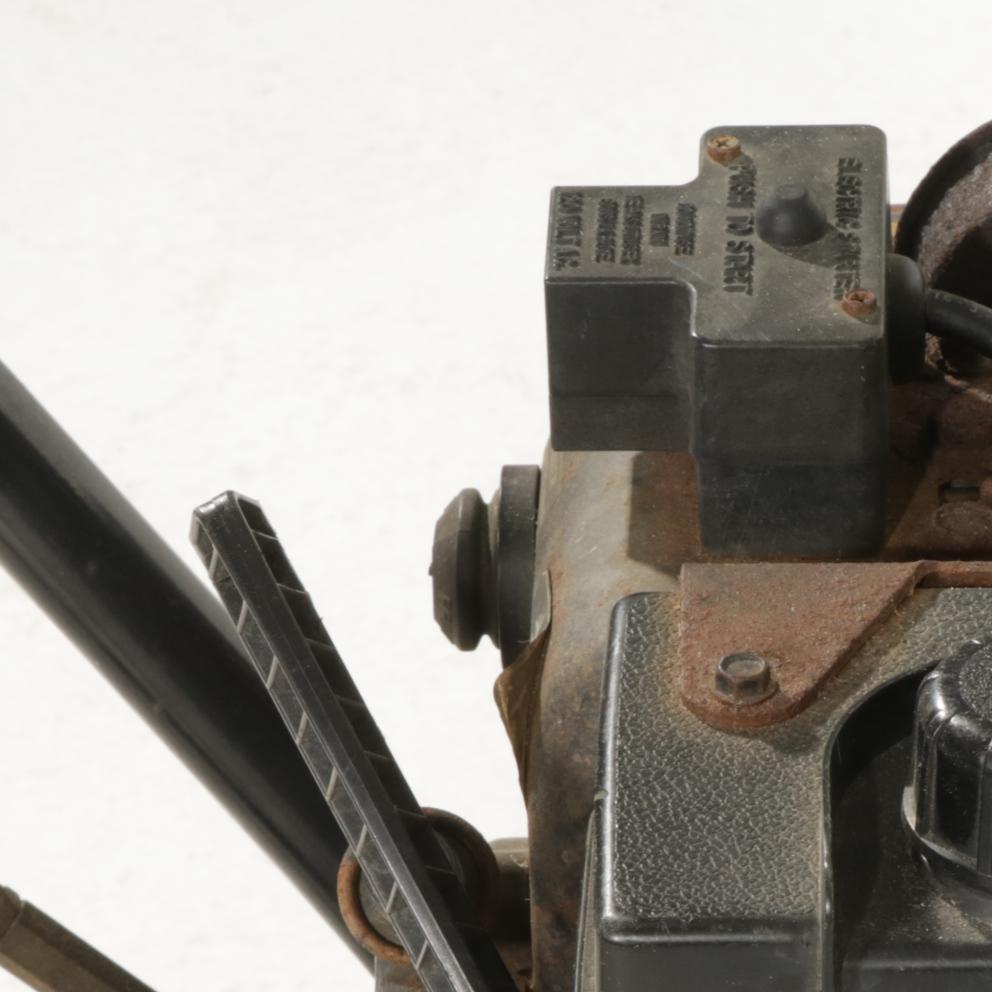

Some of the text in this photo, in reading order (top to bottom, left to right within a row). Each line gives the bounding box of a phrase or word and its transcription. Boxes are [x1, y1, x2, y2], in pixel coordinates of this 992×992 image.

[722, 165, 757, 296] PUSH TO START
[835, 157, 863, 230] ELECTRIC
